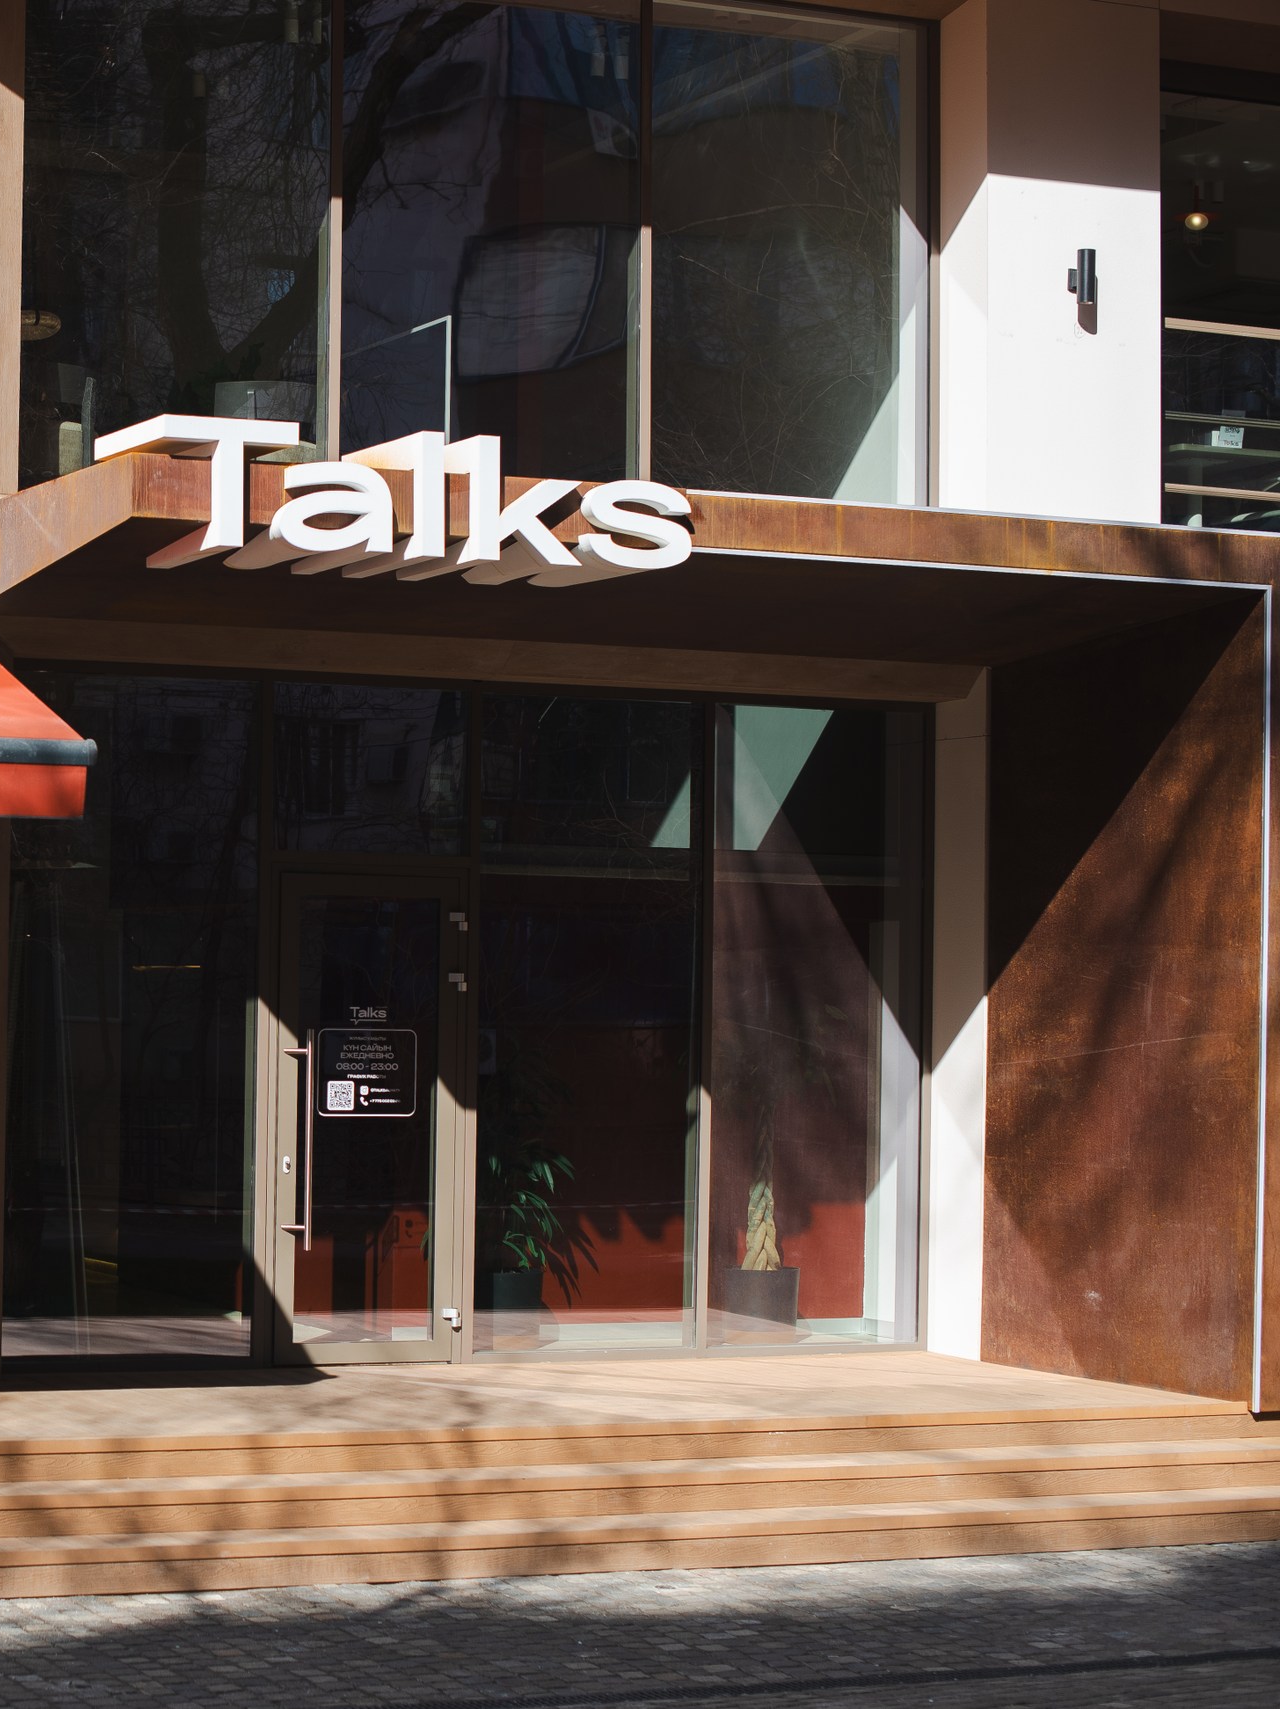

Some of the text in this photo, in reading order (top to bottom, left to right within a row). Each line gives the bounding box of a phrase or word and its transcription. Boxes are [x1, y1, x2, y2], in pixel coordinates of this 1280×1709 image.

[94, 413, 693, 570] Talks
[349, 1006, 387, 1018] Talks
[360, 1043, 391, 1051] САЙЫН
